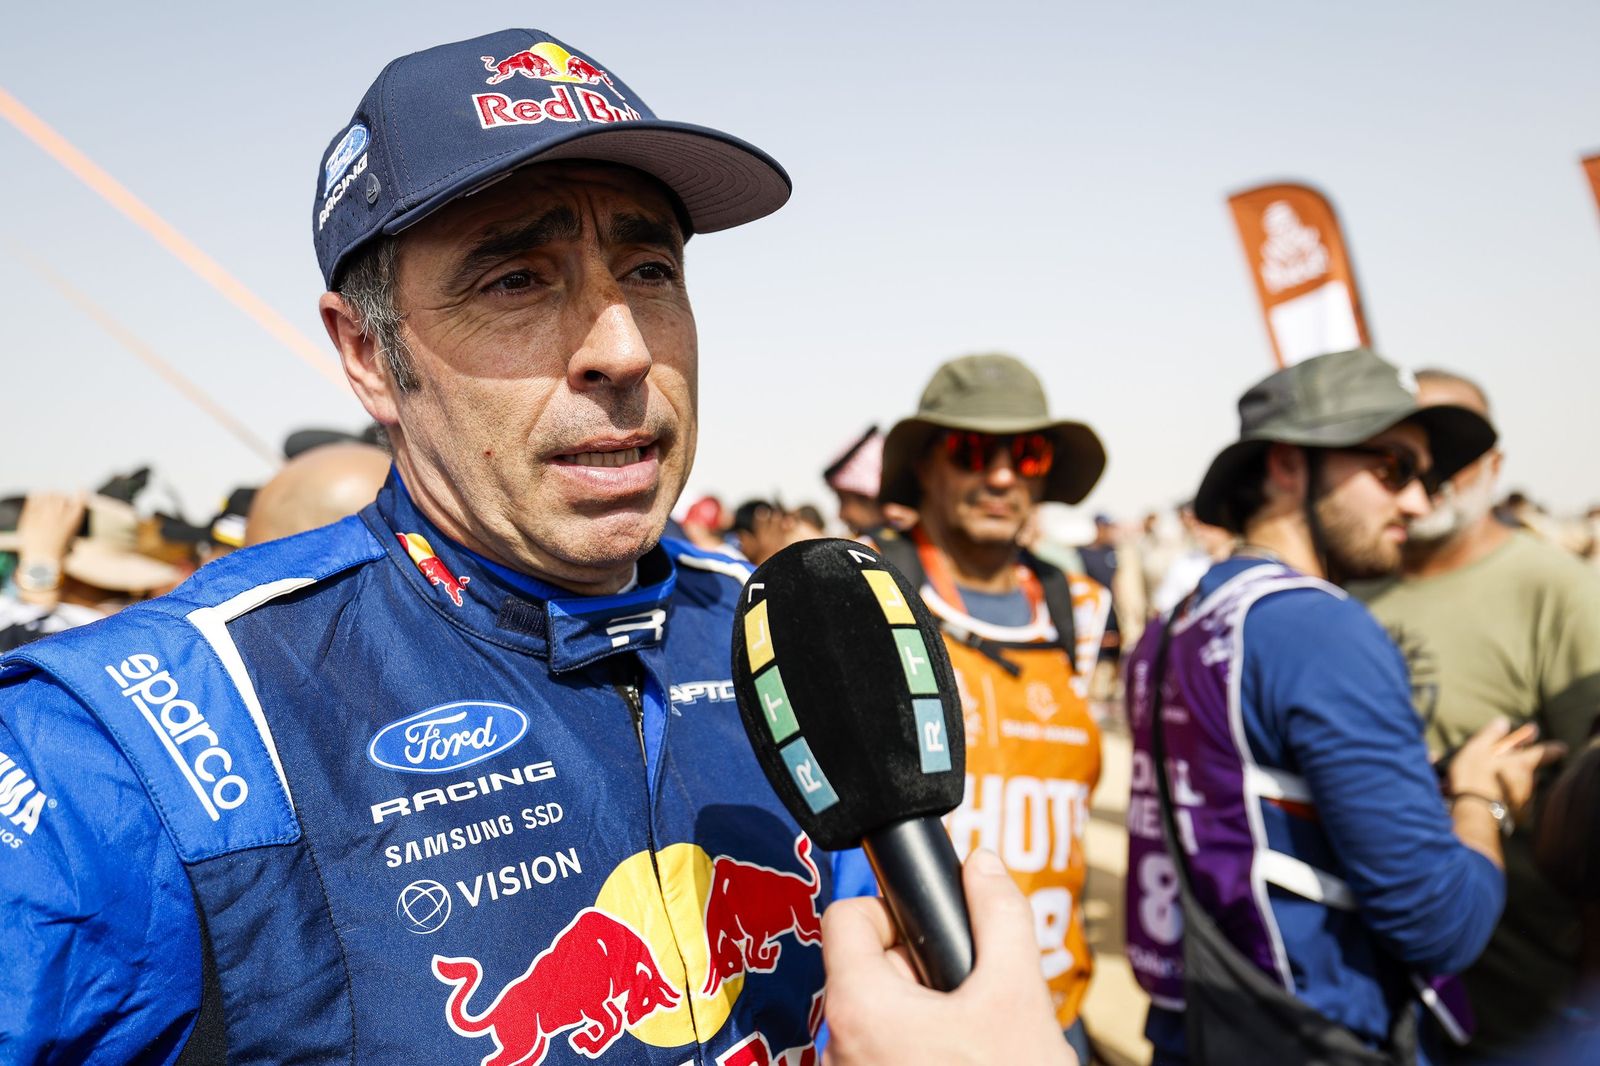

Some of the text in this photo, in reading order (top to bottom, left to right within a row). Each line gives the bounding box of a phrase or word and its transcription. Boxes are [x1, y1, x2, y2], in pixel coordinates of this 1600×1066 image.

[472, 85, 581, 129] Red
[319, 152, 367, 231] RACING
[118, 653, 249, 811] sparco
[404, 711, 497, 764] Ford
[370, 761, 556, 824] RACING
[384, 802, 563, 868] SAMSUNG SSD
[456, 847, 582, 907] VISION
